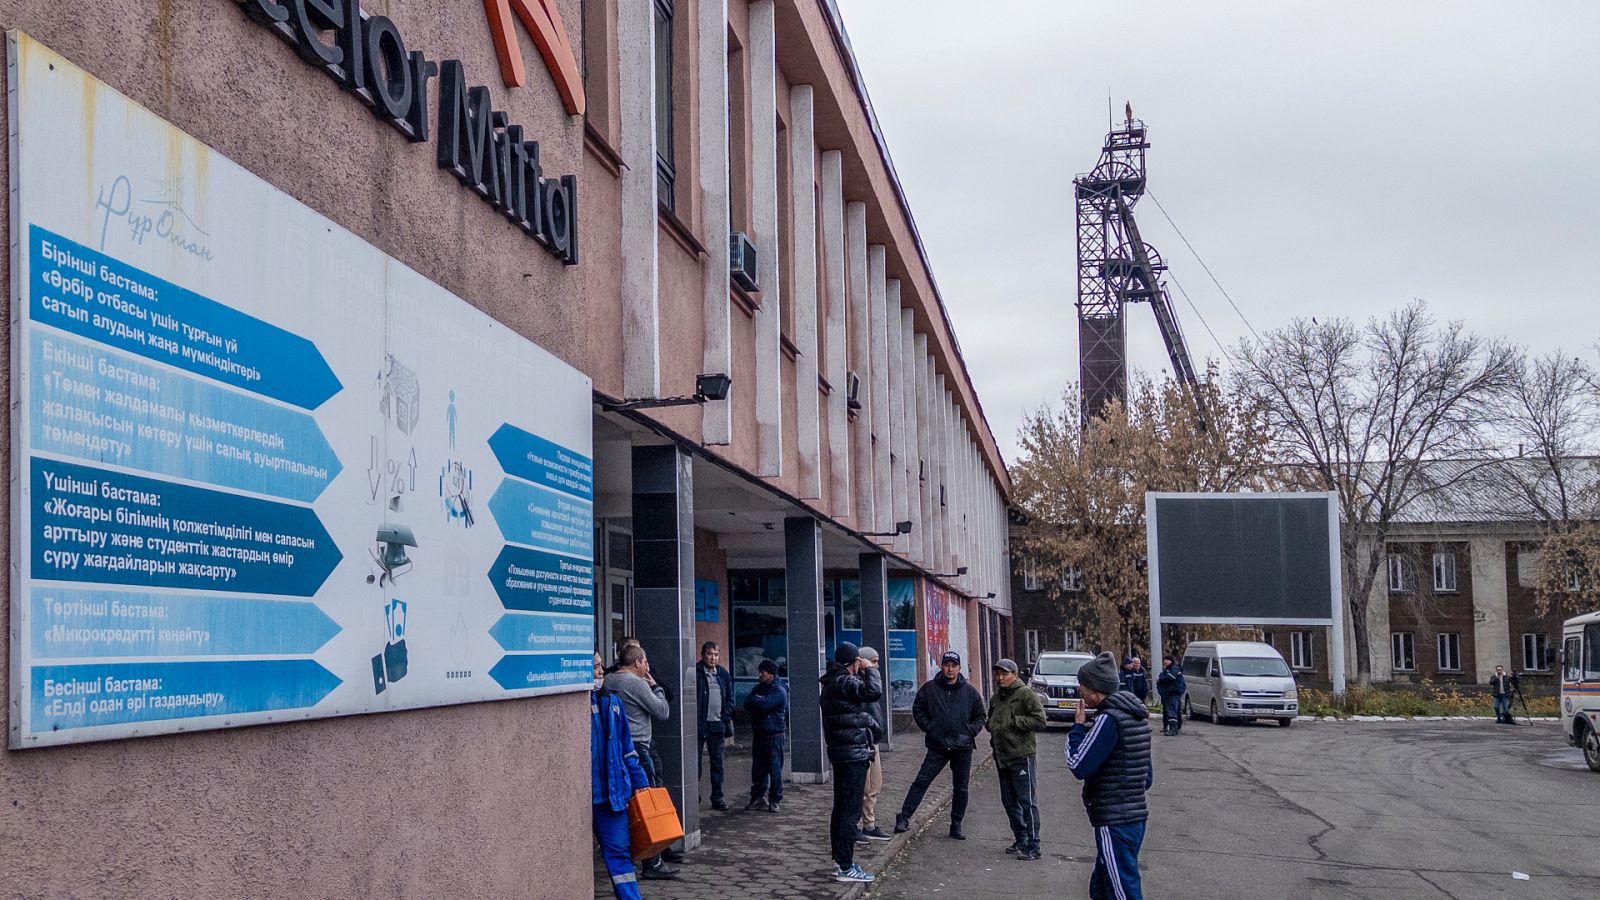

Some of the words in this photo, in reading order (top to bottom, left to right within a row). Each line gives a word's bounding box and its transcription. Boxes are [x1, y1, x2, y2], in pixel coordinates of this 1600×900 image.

[42, 240, 96, 277] Бірінші
[100, 265, 158, 302] бастама:
[42, 270, 94, 303] «Әрбір
[97, 291, 147, 320] отбасы
[150, 311, 179, 332] үшін
[182, 323, 222, 348] тұрғын
[225, 338, 238, 354] үй
[42, 296, 89, 323] сатып
[93, 313, 145, 342] алудың
[148, 333, 179, 355] жаңа
[182, 345, 261, 381] мүмкіндіктері»
[43, 341, 94, 372] Екінші
[98, 358, 160, 392] бастама:
[43, 371, 101, 400] «Төмен
[105, 389, 185, 423] жалдамалы
[43, 400, 133, 433] жалақысын
[138, 423, 182, 448] көтеру
[185, 435, 213, 454] үшін
[216, 442, 252, 464] салық
[253, 453, 328, 480] ауыртпалығын
[43, 424, 132, 458] төмендету»
[43, 471, 97, 496] Үшінші
[101, 482, 161, 506] бастама:
[44, 498, 112, 524] «Жоғары
[116, 507, 170, 533] білімнің
[173, 519, 252, 541] қолжетімділігі
[255, 530, 273, 543] мен
[275, 534, 315, 549] сапасын
[44, 524, 107, 548] арттыру
[111, 533, 144, 549] және
[147, 537, 209, 555] студенттік
[212, 544, 271, 564] жастардың
[272, 551, 294, 568] өмір
[44, 550, 80, 570] сүру
[83, 553, 176, 576] жағдайларын
[178, 562, 237, 582] жақсарту»
[44, 598, 108, 619] Төртінші
[112, 600, 168, 618] бастама:
[44, 624, 155, 646] «Микрокредитті
[44, 677, 101, 697] Бесінші
[105, 676, 163, 694] бастама:
[44, 699, 86, 717] «Елді
[90, 699, 123, 713] одан
[127, 694, 146, 713] әрі
[149, 692, 225, 708] газдандыру»
